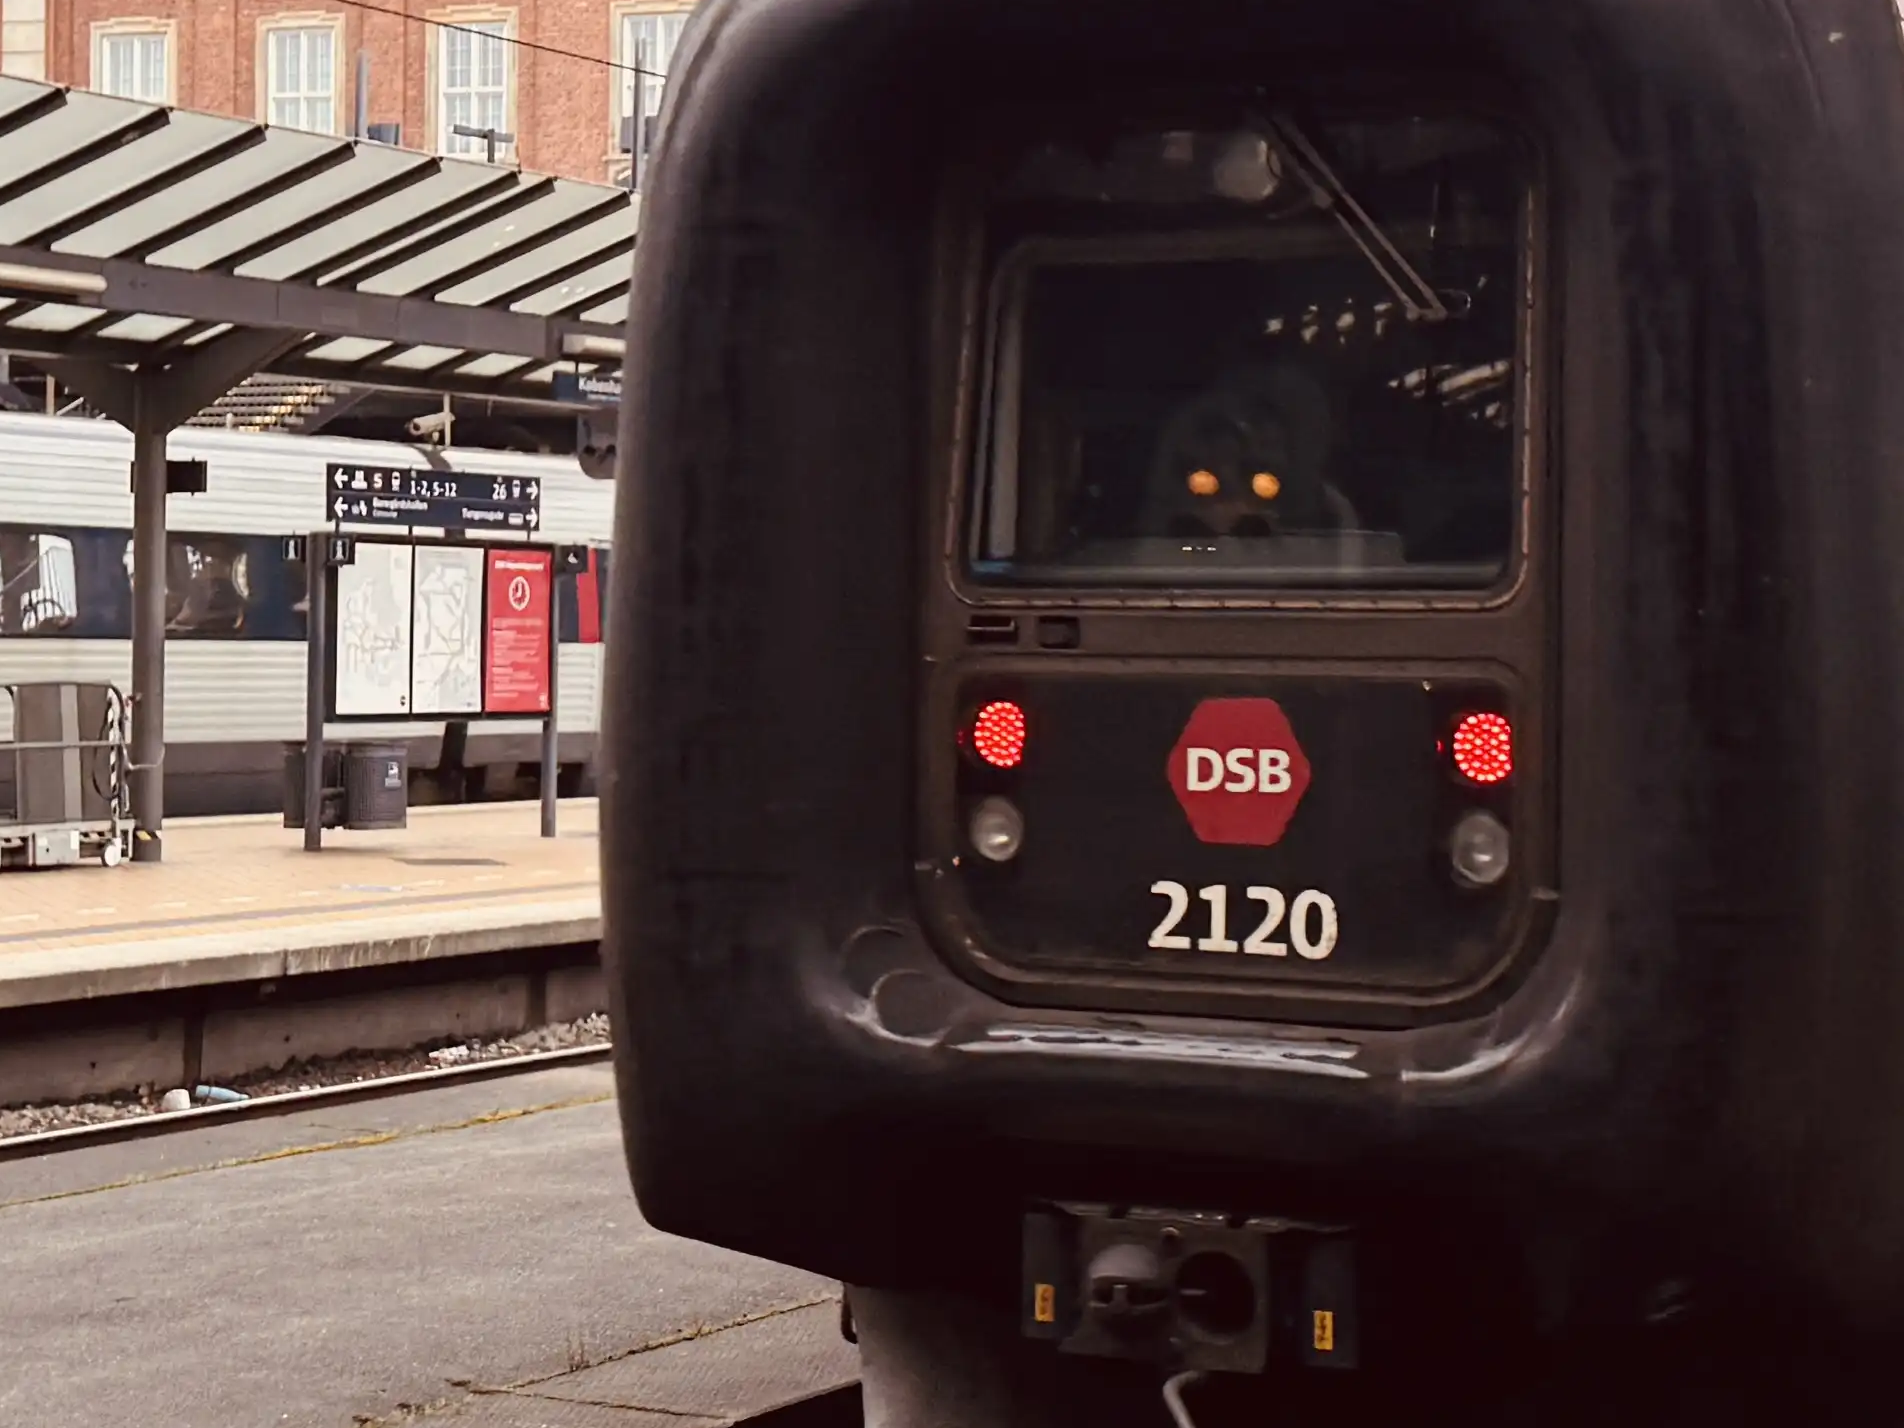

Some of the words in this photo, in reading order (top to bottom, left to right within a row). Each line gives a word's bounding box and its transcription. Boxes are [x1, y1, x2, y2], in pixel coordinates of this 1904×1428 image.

[492, 483, 508, 501] 26
[1186, 747, 1292, 794] DSB
[1147, 879, 1339, 960] 2120
